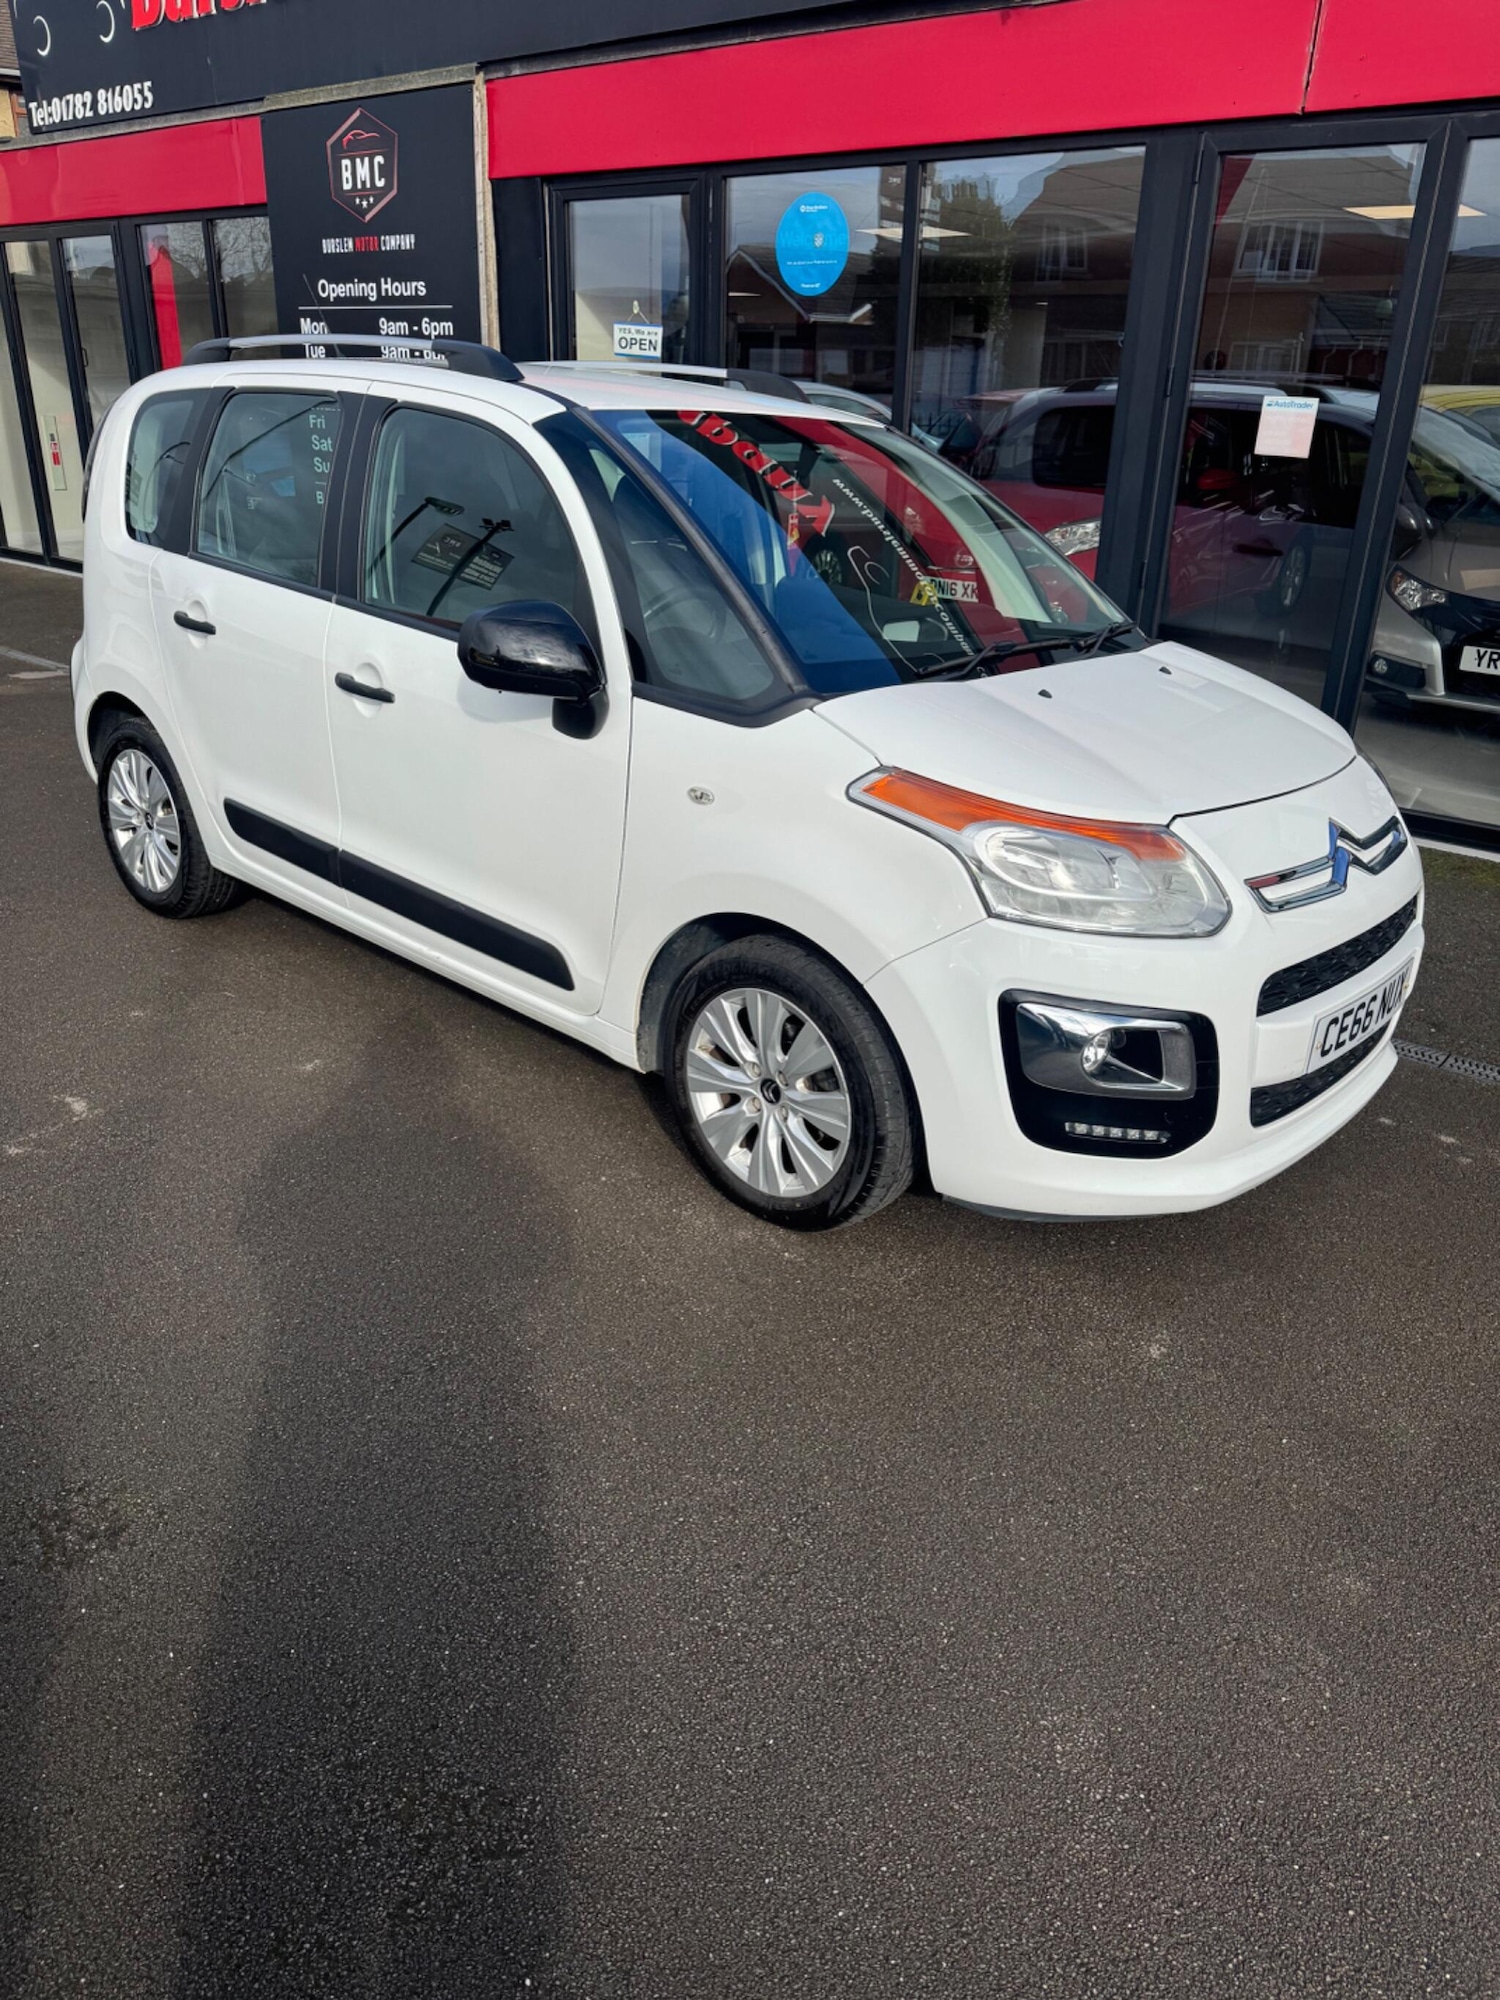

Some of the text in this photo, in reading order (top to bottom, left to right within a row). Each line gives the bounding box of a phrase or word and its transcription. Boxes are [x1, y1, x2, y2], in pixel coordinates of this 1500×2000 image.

[29, 81, 154, 127] Tel:01782 816055
[341, 155, 386, 191] BMC
[322, 233, 416, 254] BURSLEM MOTOR COMPANY
[317, 277, 427, 302] Opening Hours
[300, 317, 328, 334] Mon
[379, 317, 409, 336] 9am
[421, 317, 454, 339] 6pm
[303, 343, 326, 358] Tue
[618, 336, 658, 353] OPEN
[309, 414, 326, 429] Fri
[311, 434, 333, 452] Sat
[313, 456, 331, 473] Su
[1320, 994, 1378, 1058] CE66
